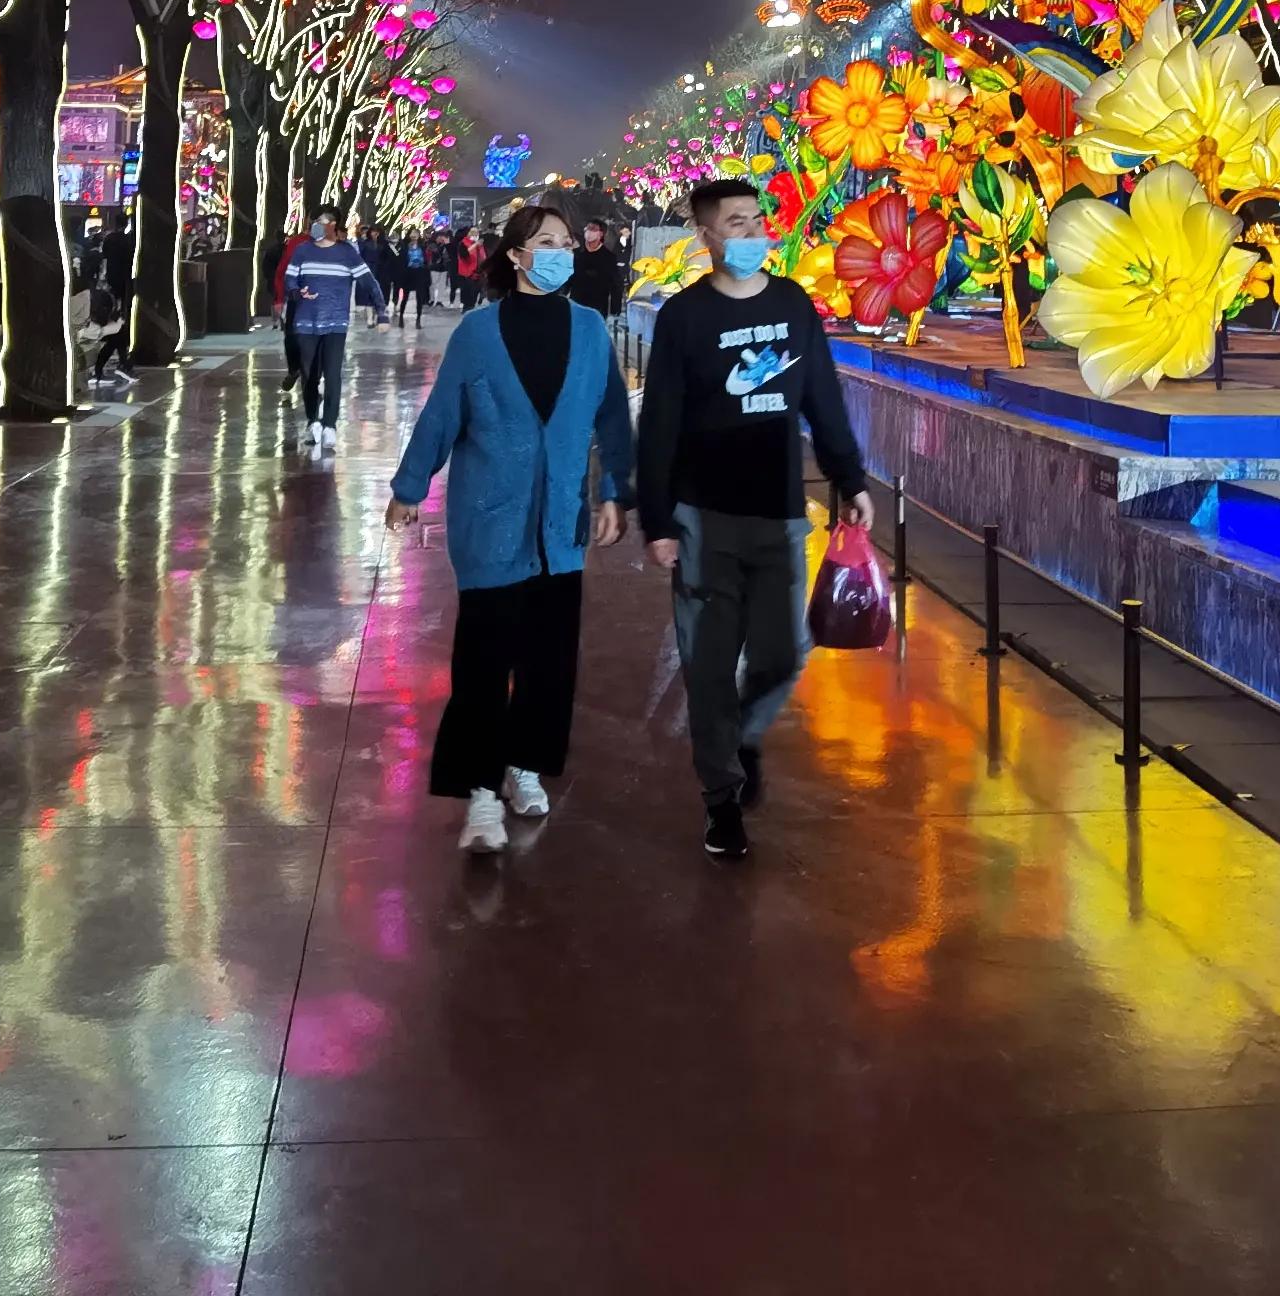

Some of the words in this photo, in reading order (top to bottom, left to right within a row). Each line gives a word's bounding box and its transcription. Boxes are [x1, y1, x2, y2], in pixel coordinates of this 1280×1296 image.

[718, 327, 754, 350] JUST
[754, 325, 776, 343] DO
[775, 322, 789, 340] IT
